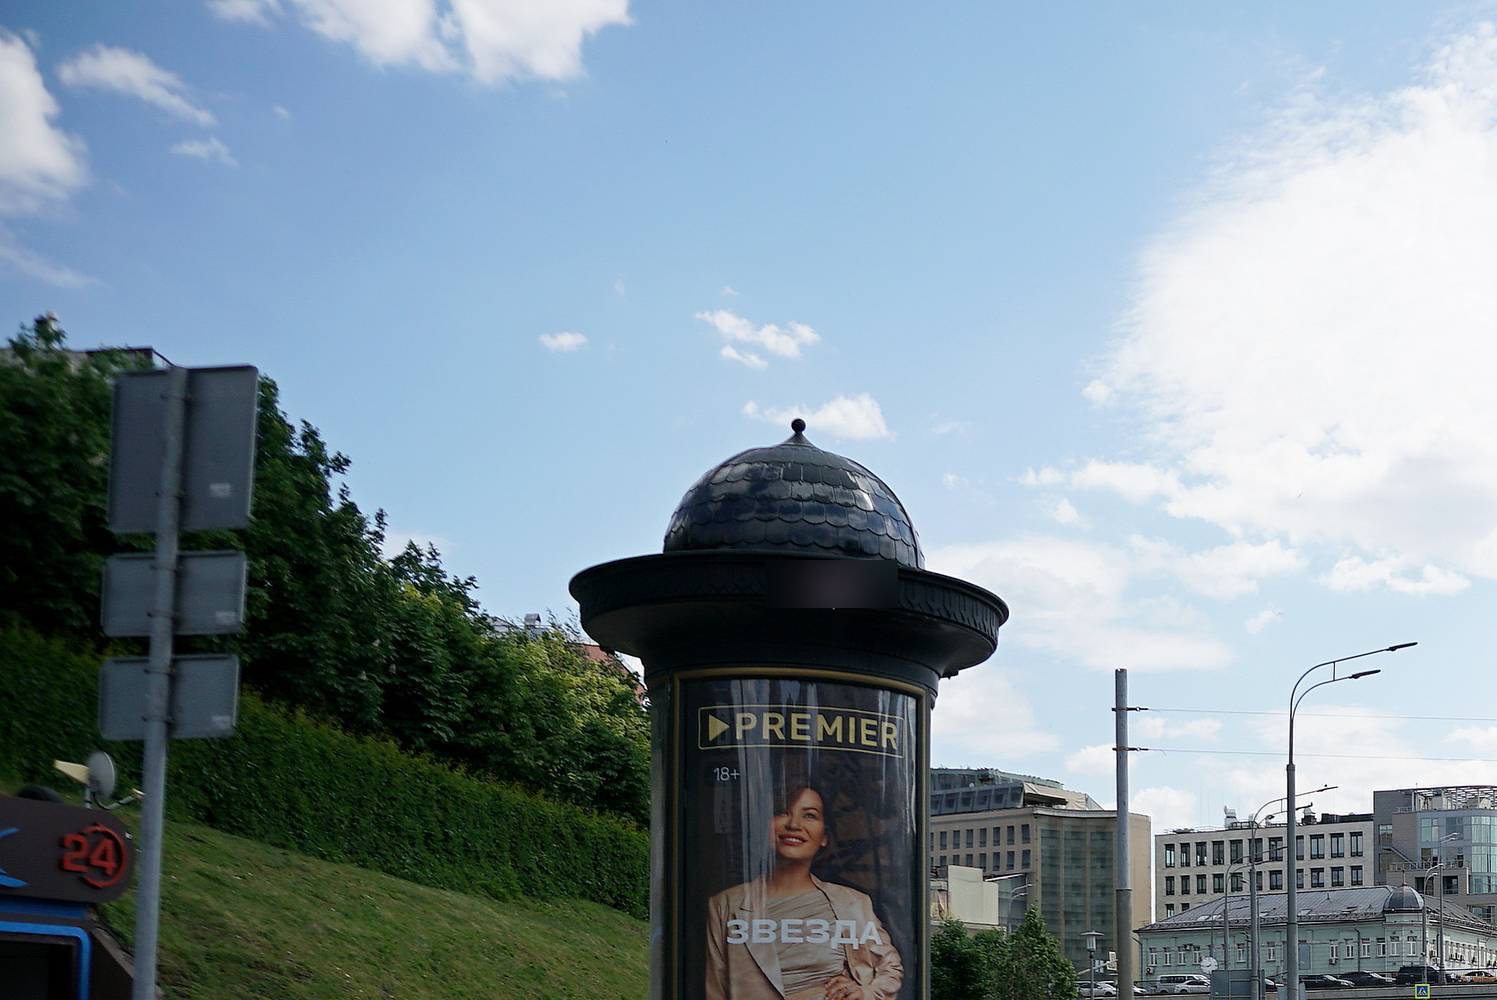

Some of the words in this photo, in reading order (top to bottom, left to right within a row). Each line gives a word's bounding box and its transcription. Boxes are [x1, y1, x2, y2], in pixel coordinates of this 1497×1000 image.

[735, 712, 898, 750] PREMIER
[713, 766, 740, 782] 18+
[62, 832, 117, 877] 24
[726, 918, 884, 950] ЗВЕЗДА
